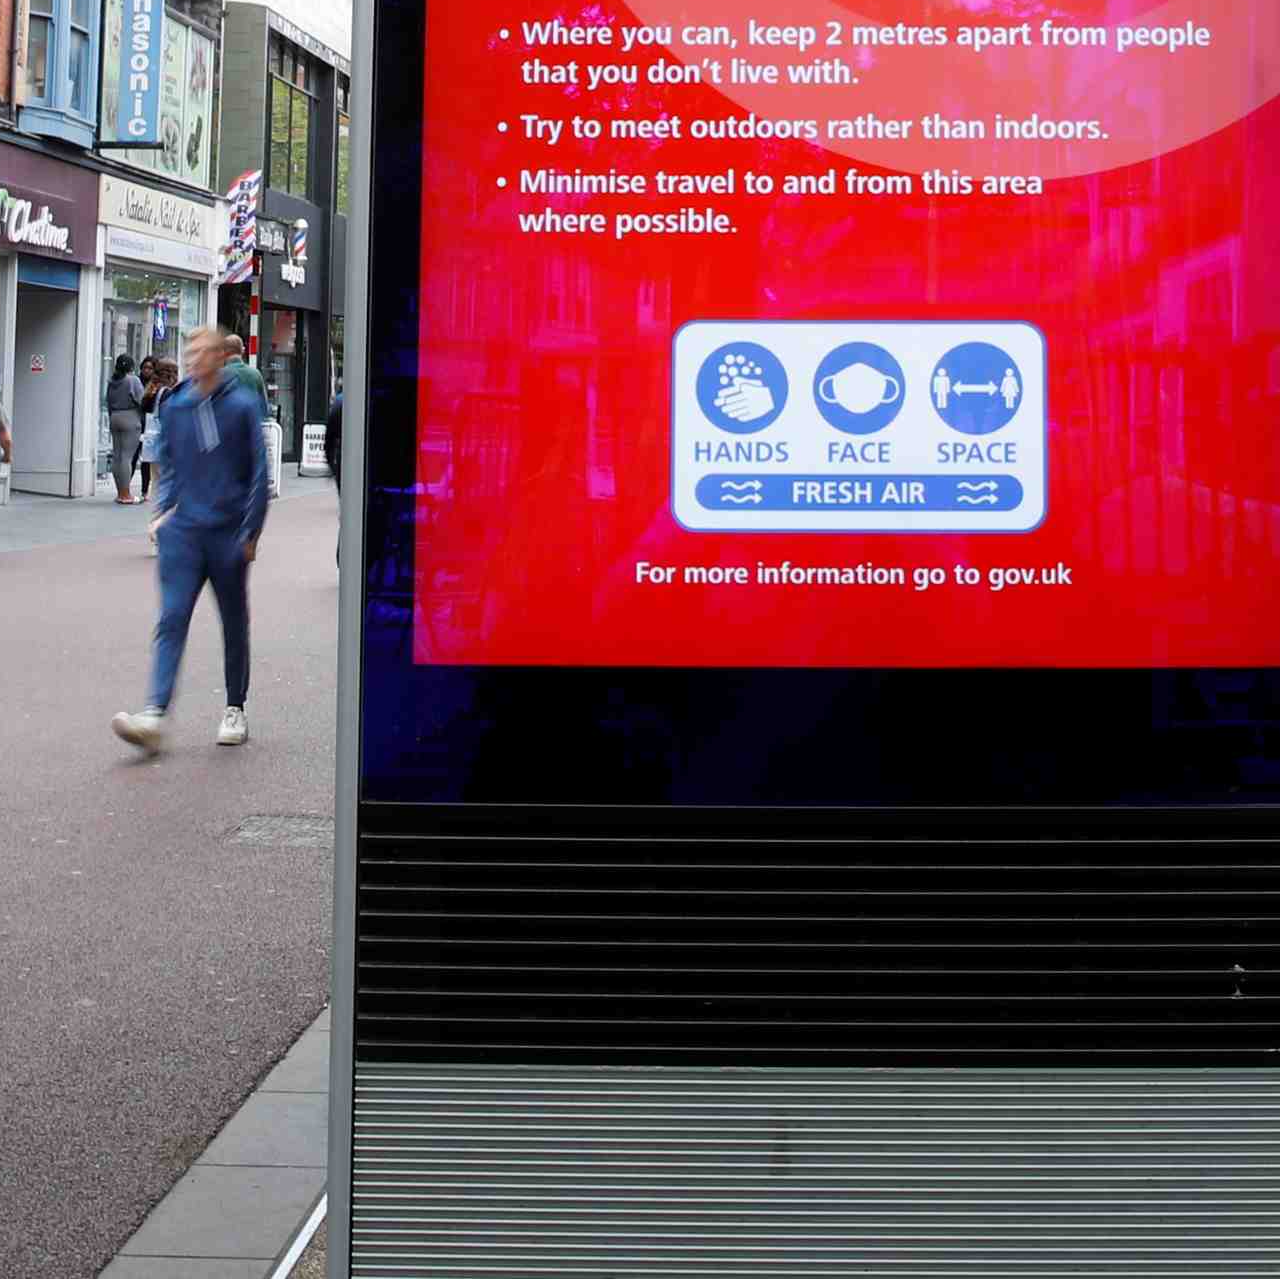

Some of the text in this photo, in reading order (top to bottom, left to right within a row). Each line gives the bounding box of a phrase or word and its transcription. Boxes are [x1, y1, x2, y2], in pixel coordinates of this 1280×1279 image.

[521, 20, 1211, 52] Where you can, keep 2 metres apart from people
[521, 59, 578, 84] that
[587, 65, 638, 91] you
[731, 58, 779, 84] live
[786, 58, 859, 84] with.
[520, 113, 1109, 144] Try to meet outdoors rather than indoors.
[520, 169, 1043, 195] Minimise travel to and from this area
[8, 199, 68, 251] Chatime
[230, 181, 253, 249] BARBER
[518, 208, 738, 239] where possible.
[694, 441, 1018, 464] HANDS FACE SPACE
[792, 481, 925, 504] FRESH AIR
[635, 561, 1073, 592] For more information go to gov.uk
